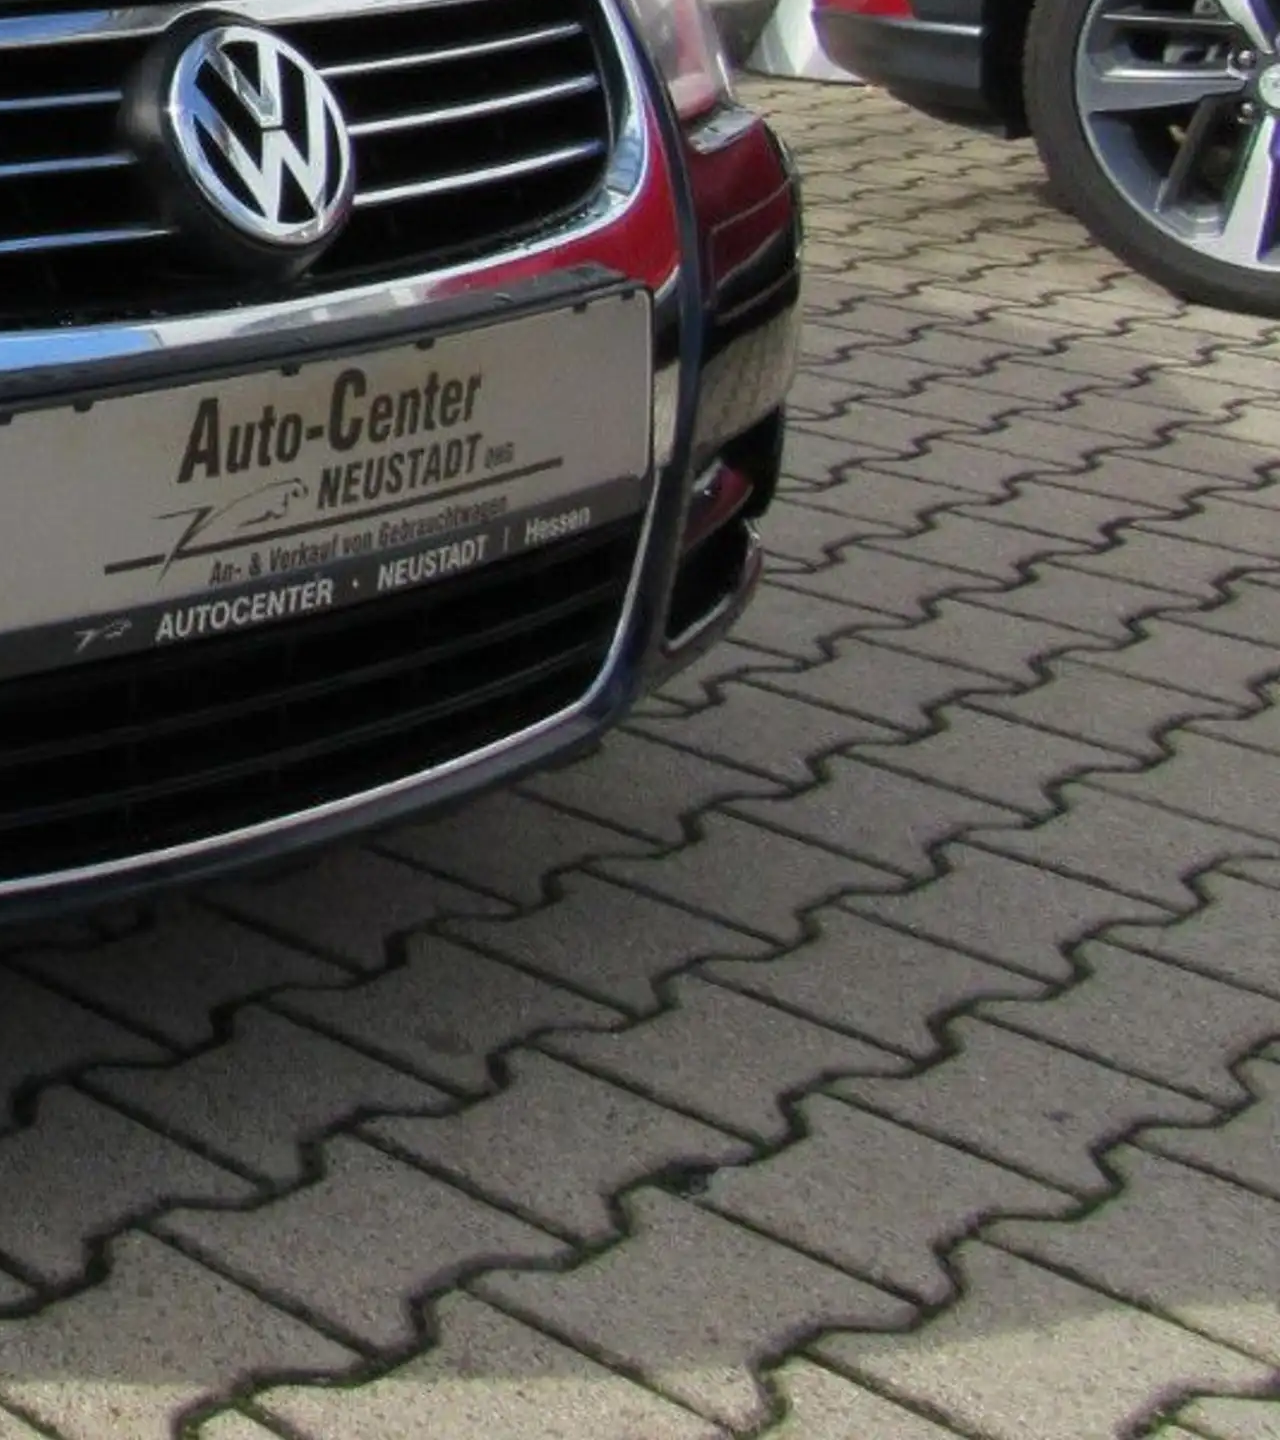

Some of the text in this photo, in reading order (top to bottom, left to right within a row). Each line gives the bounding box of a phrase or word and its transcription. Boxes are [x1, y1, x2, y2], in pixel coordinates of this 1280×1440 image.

[178, 368, 481, 483] Auto-Center
[317, 433, 483, 510] NEUSTADT
[154, 505, 591, 643] AUTOCENTER NEUSTADT Hessen
[209, 559, 242, 585] An-
[249, 552, 263, 576] &
[269, 533, 340, 573] Verkauf
[343, 529, 373, 557] von
